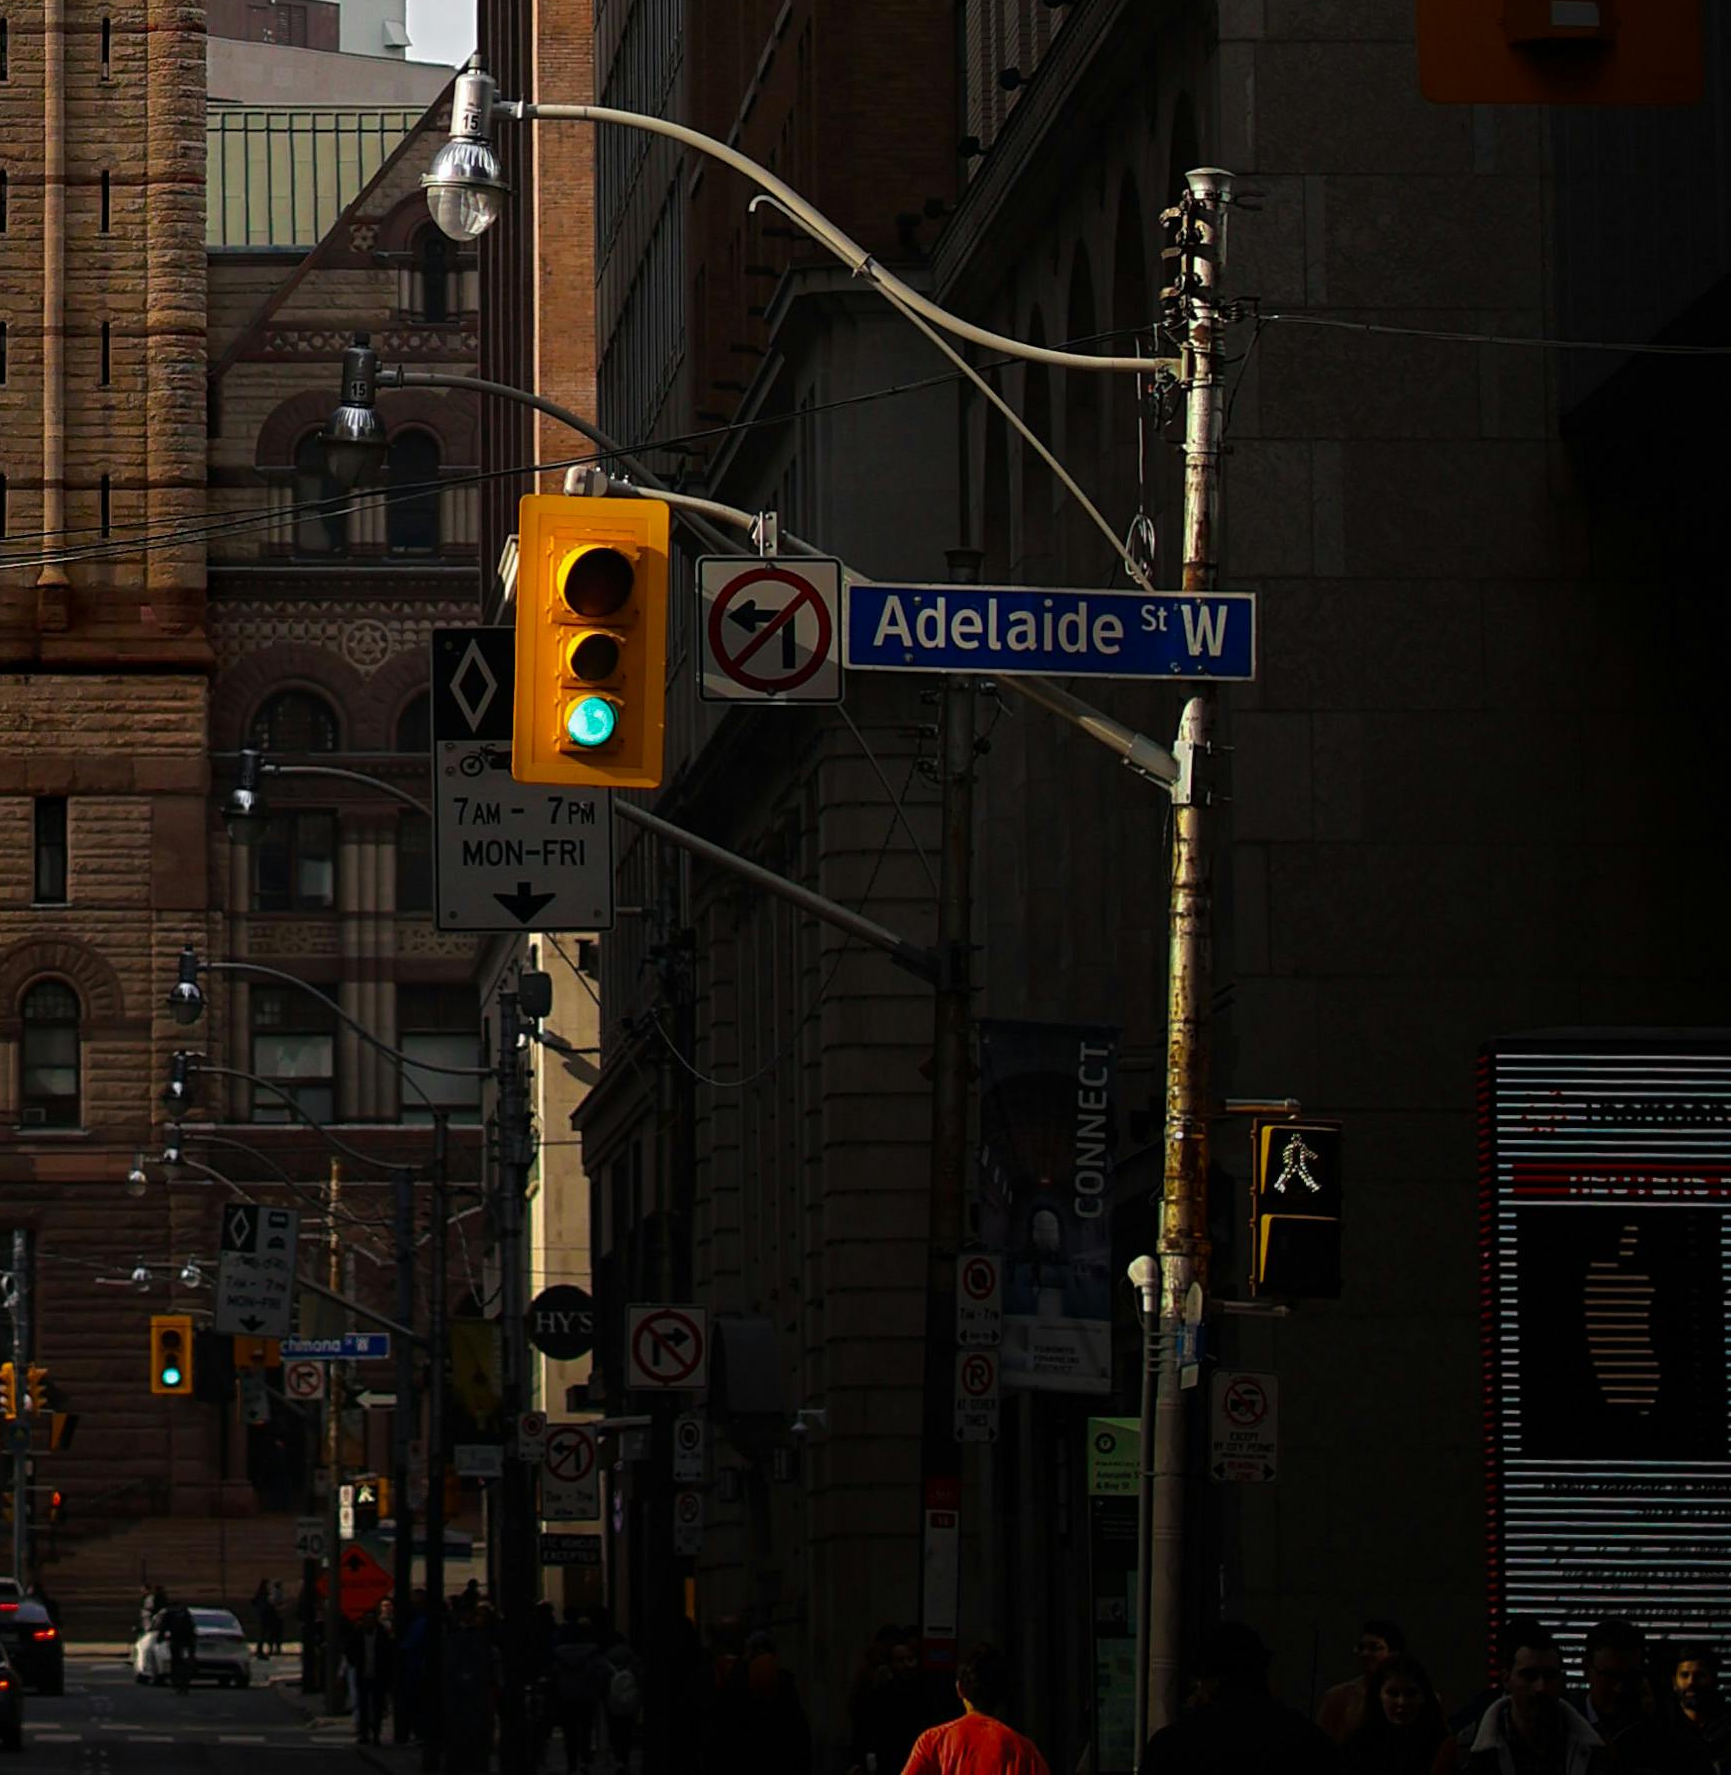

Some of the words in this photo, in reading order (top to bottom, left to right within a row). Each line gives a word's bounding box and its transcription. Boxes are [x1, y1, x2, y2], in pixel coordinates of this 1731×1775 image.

[351, 382, 366, 397] 15
[872, 594, 1126, 656] Adelaide
[1139, 603, 1169, 633] St
[1181, 603, 1229, 658] W
[462, 839, 586, 867] MON-FRI
[1073, 1040, 1111, 1220] CONNECT
[295, 1534, 323, 1554] 40
